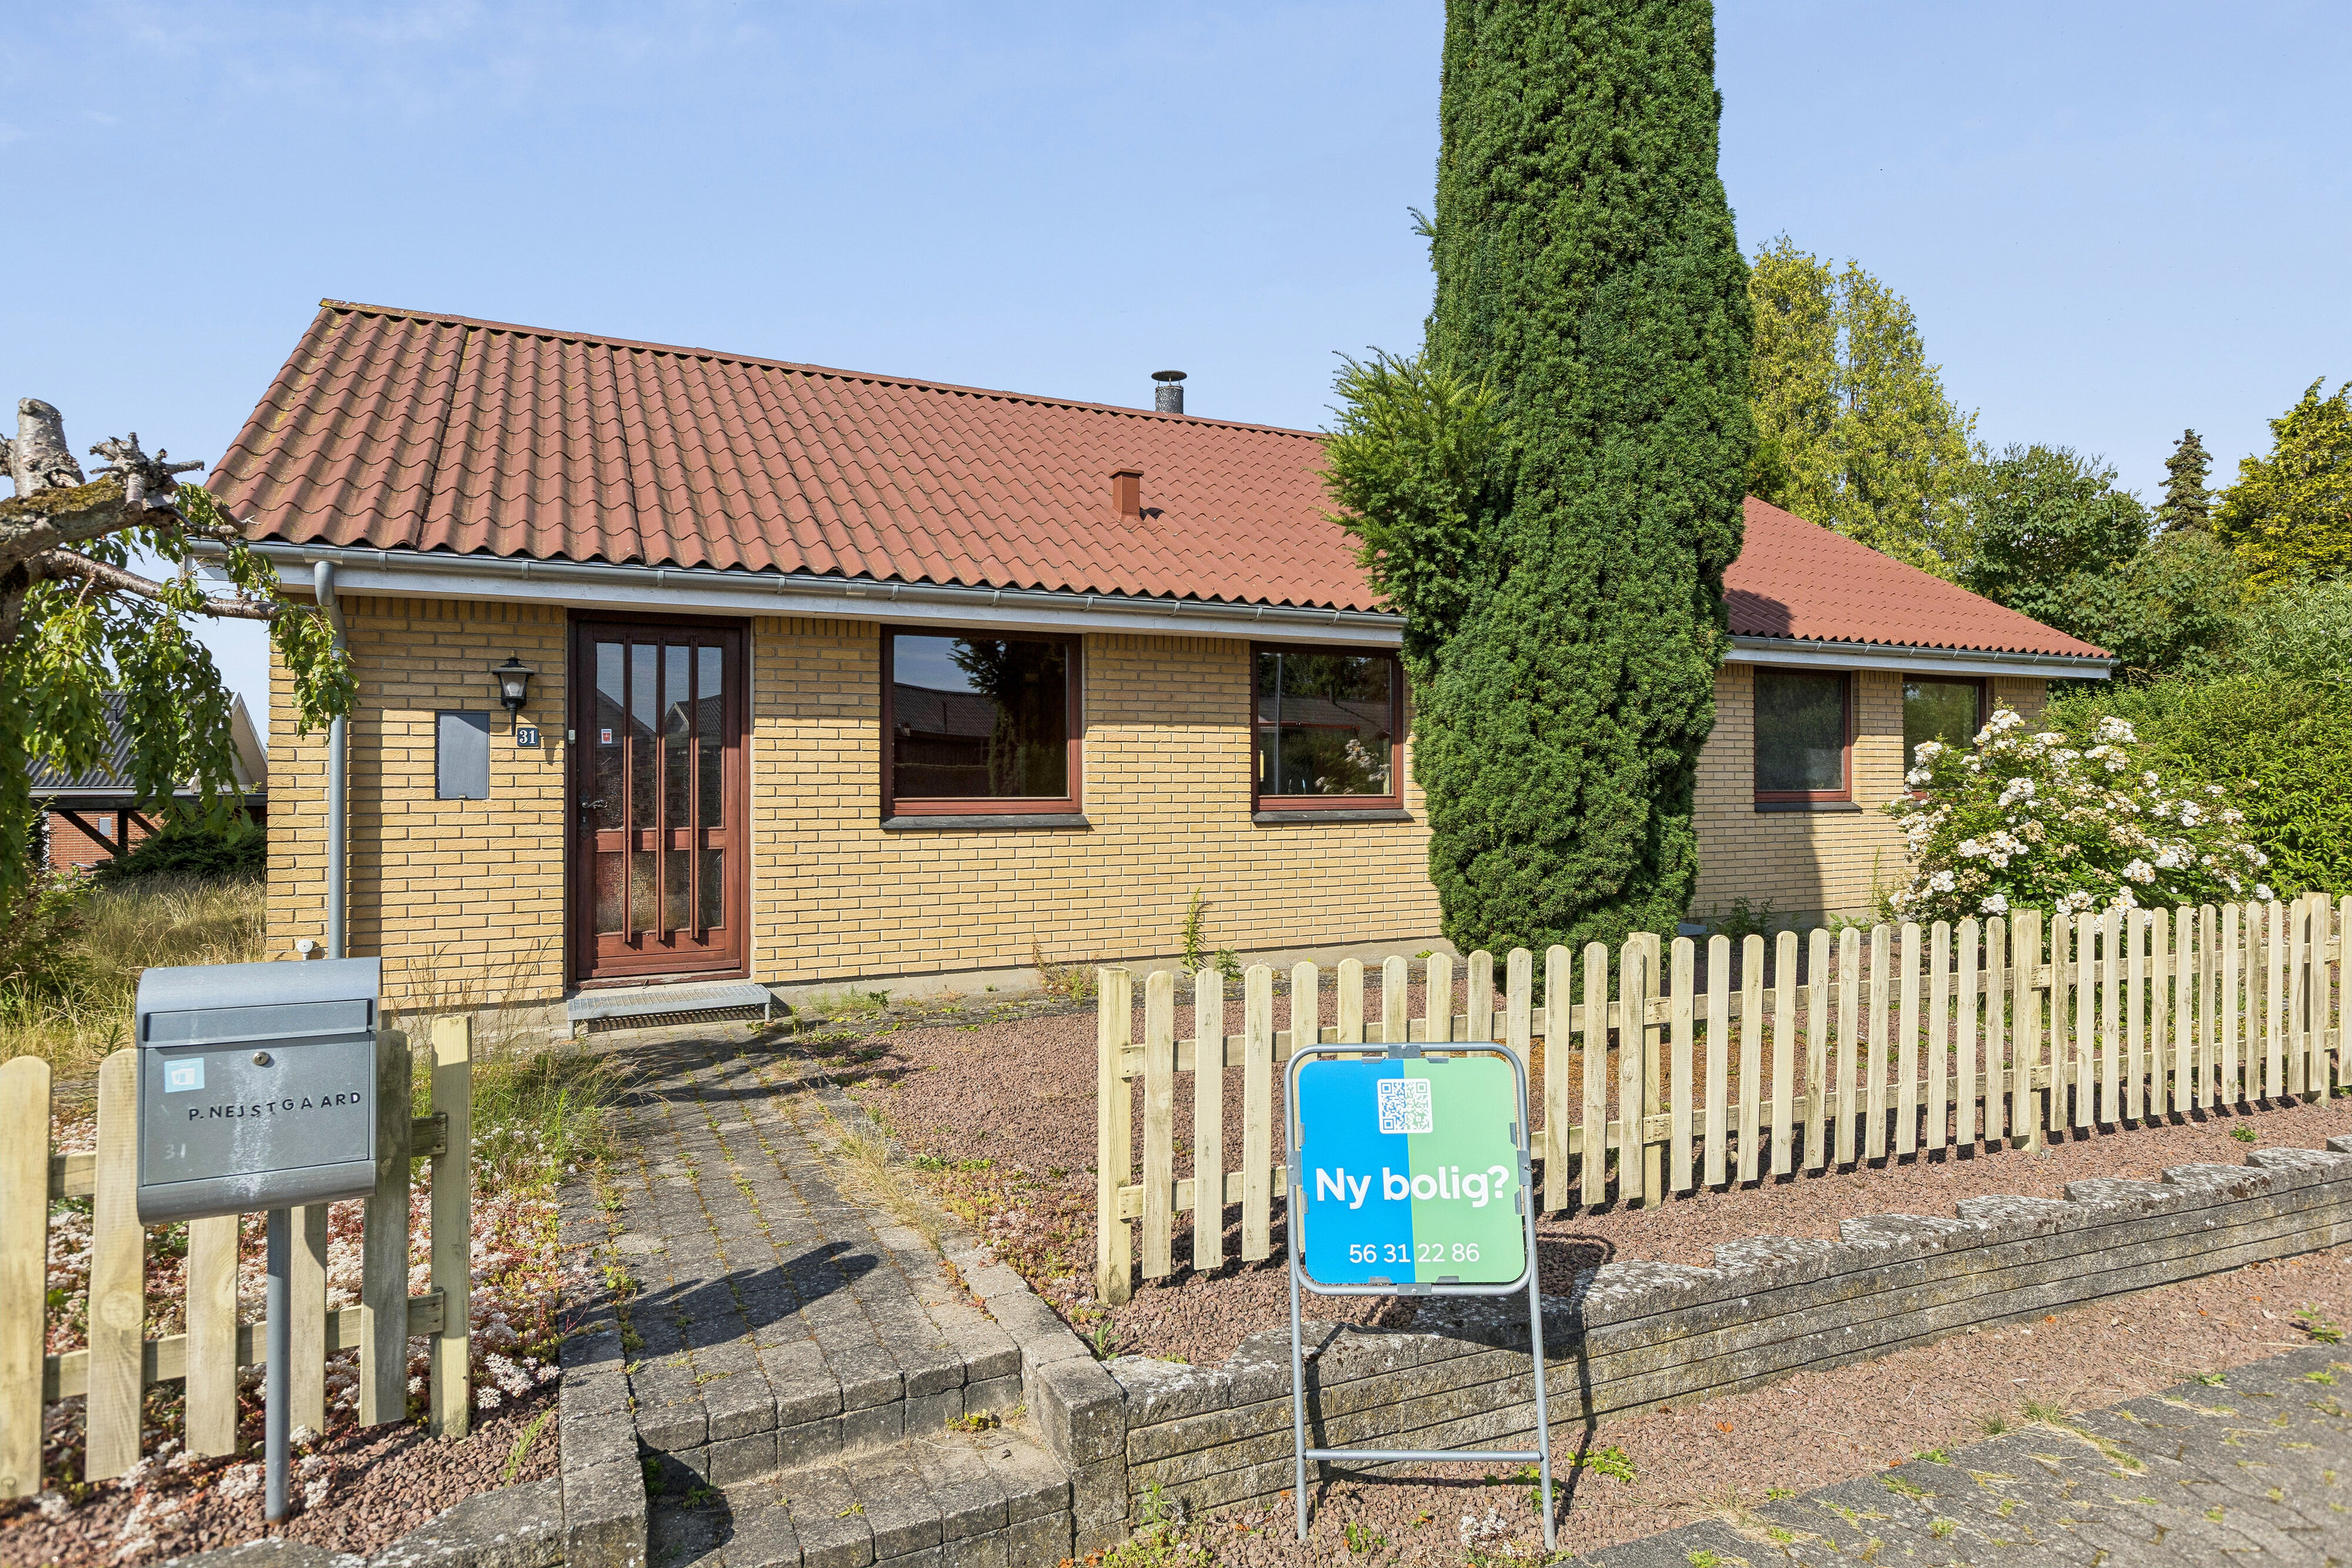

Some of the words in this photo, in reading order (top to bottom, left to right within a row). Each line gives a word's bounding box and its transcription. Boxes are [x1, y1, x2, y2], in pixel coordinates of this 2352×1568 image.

[519, 729, 535, 744] 31
[1316, 1167, 1371, 1209] Ny
[1382, 1165, 1509, 1207] bolig?
[1349, 1243, 1377, 1263] 56
[1383, 1243, 1410, 1263] 31
[1417, 1243, 1445, 1262] 22
[1452, 1243, 1479, 1262] 86
